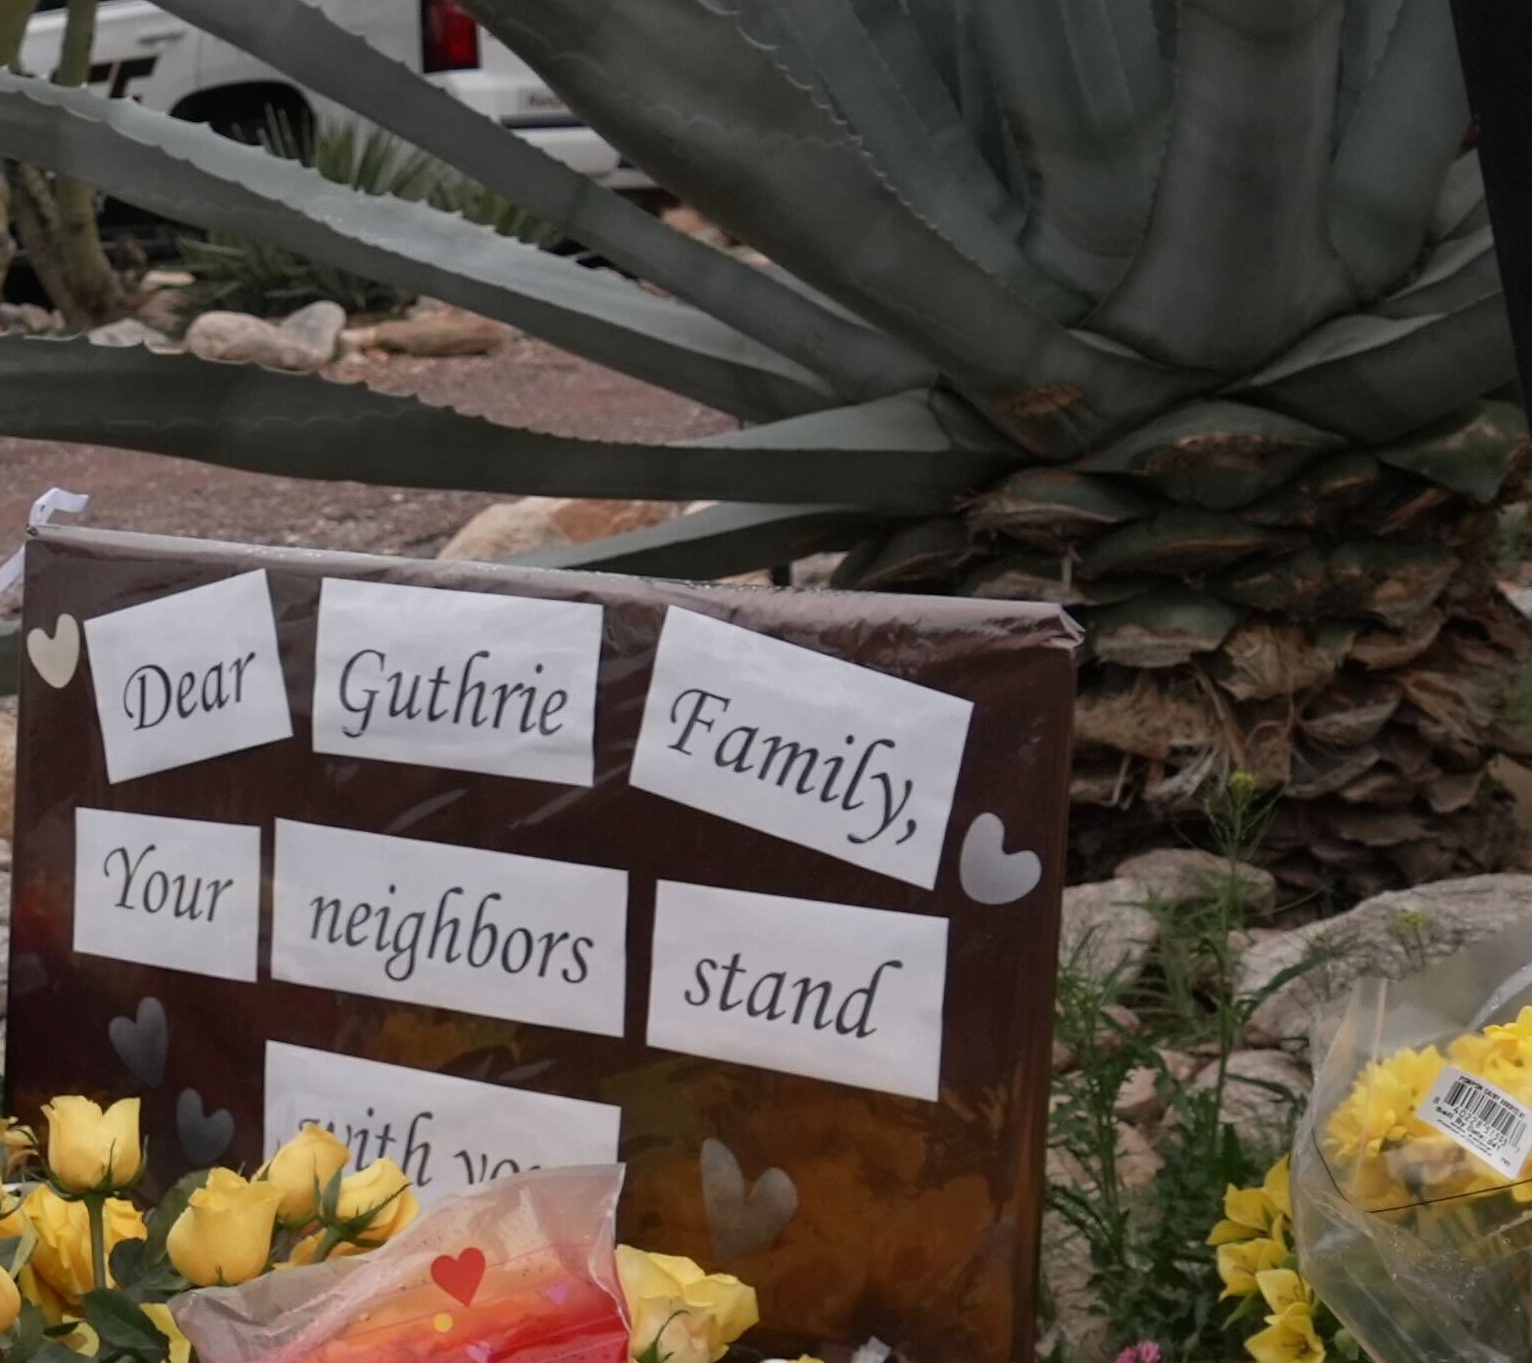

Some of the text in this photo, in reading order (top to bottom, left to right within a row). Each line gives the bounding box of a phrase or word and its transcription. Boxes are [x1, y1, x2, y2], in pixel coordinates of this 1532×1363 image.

[123, 649, 918, 845] Dear Guthrie Family,
[104, 844, 904, 1039] Your neighbors stand
